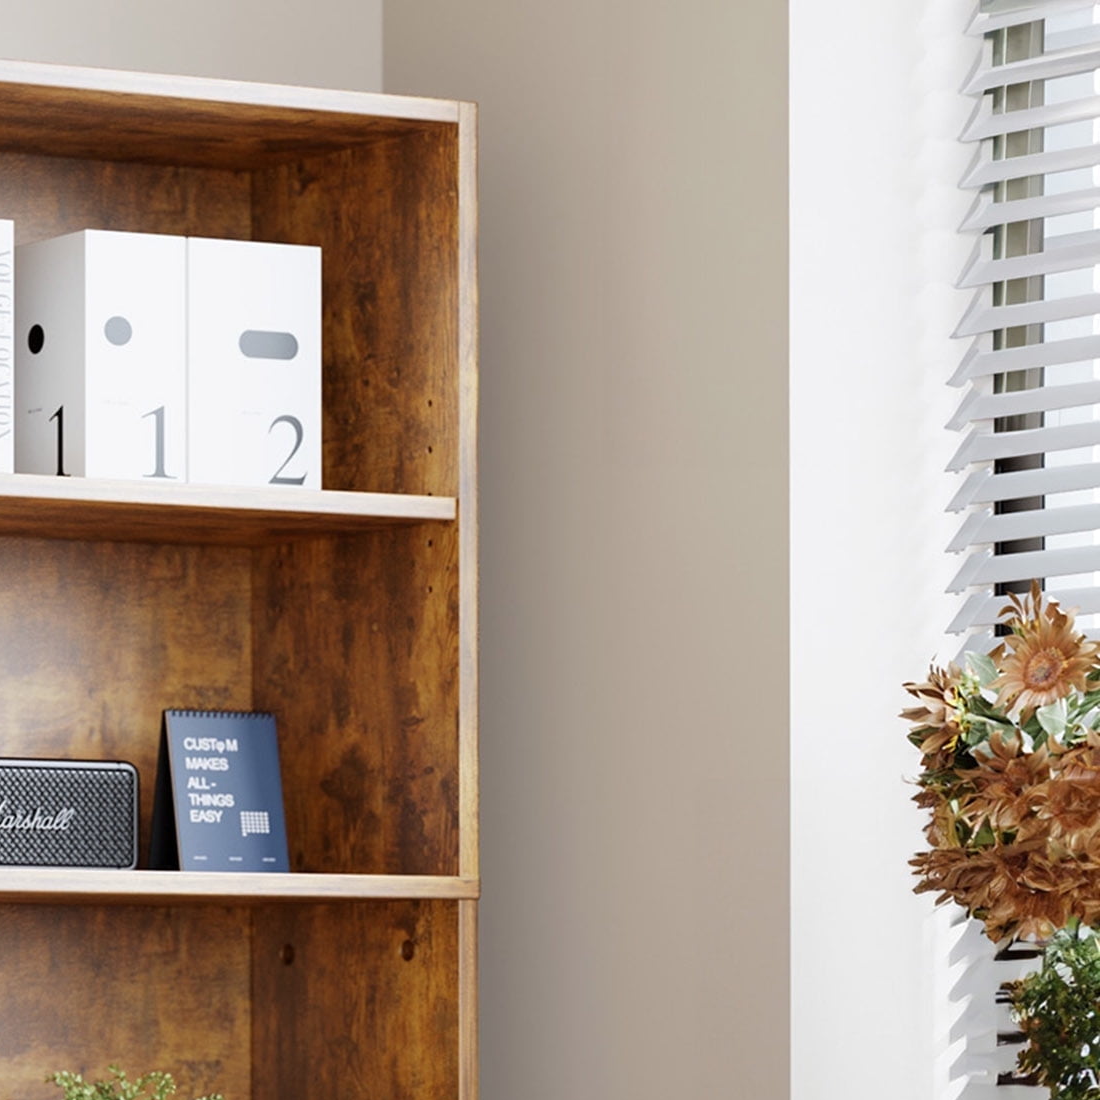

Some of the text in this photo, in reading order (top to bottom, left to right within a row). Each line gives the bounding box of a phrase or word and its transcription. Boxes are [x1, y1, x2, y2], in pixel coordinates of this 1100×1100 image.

[49, 405, 71, 478] 1
[141, 405, 177, 480] 1
[268, 414, 308, 486] 2
[185, 757, 229, 771] MAKES
[188, 793, 235, 808] THINGS
[190, 809, 223, 823] EASY
